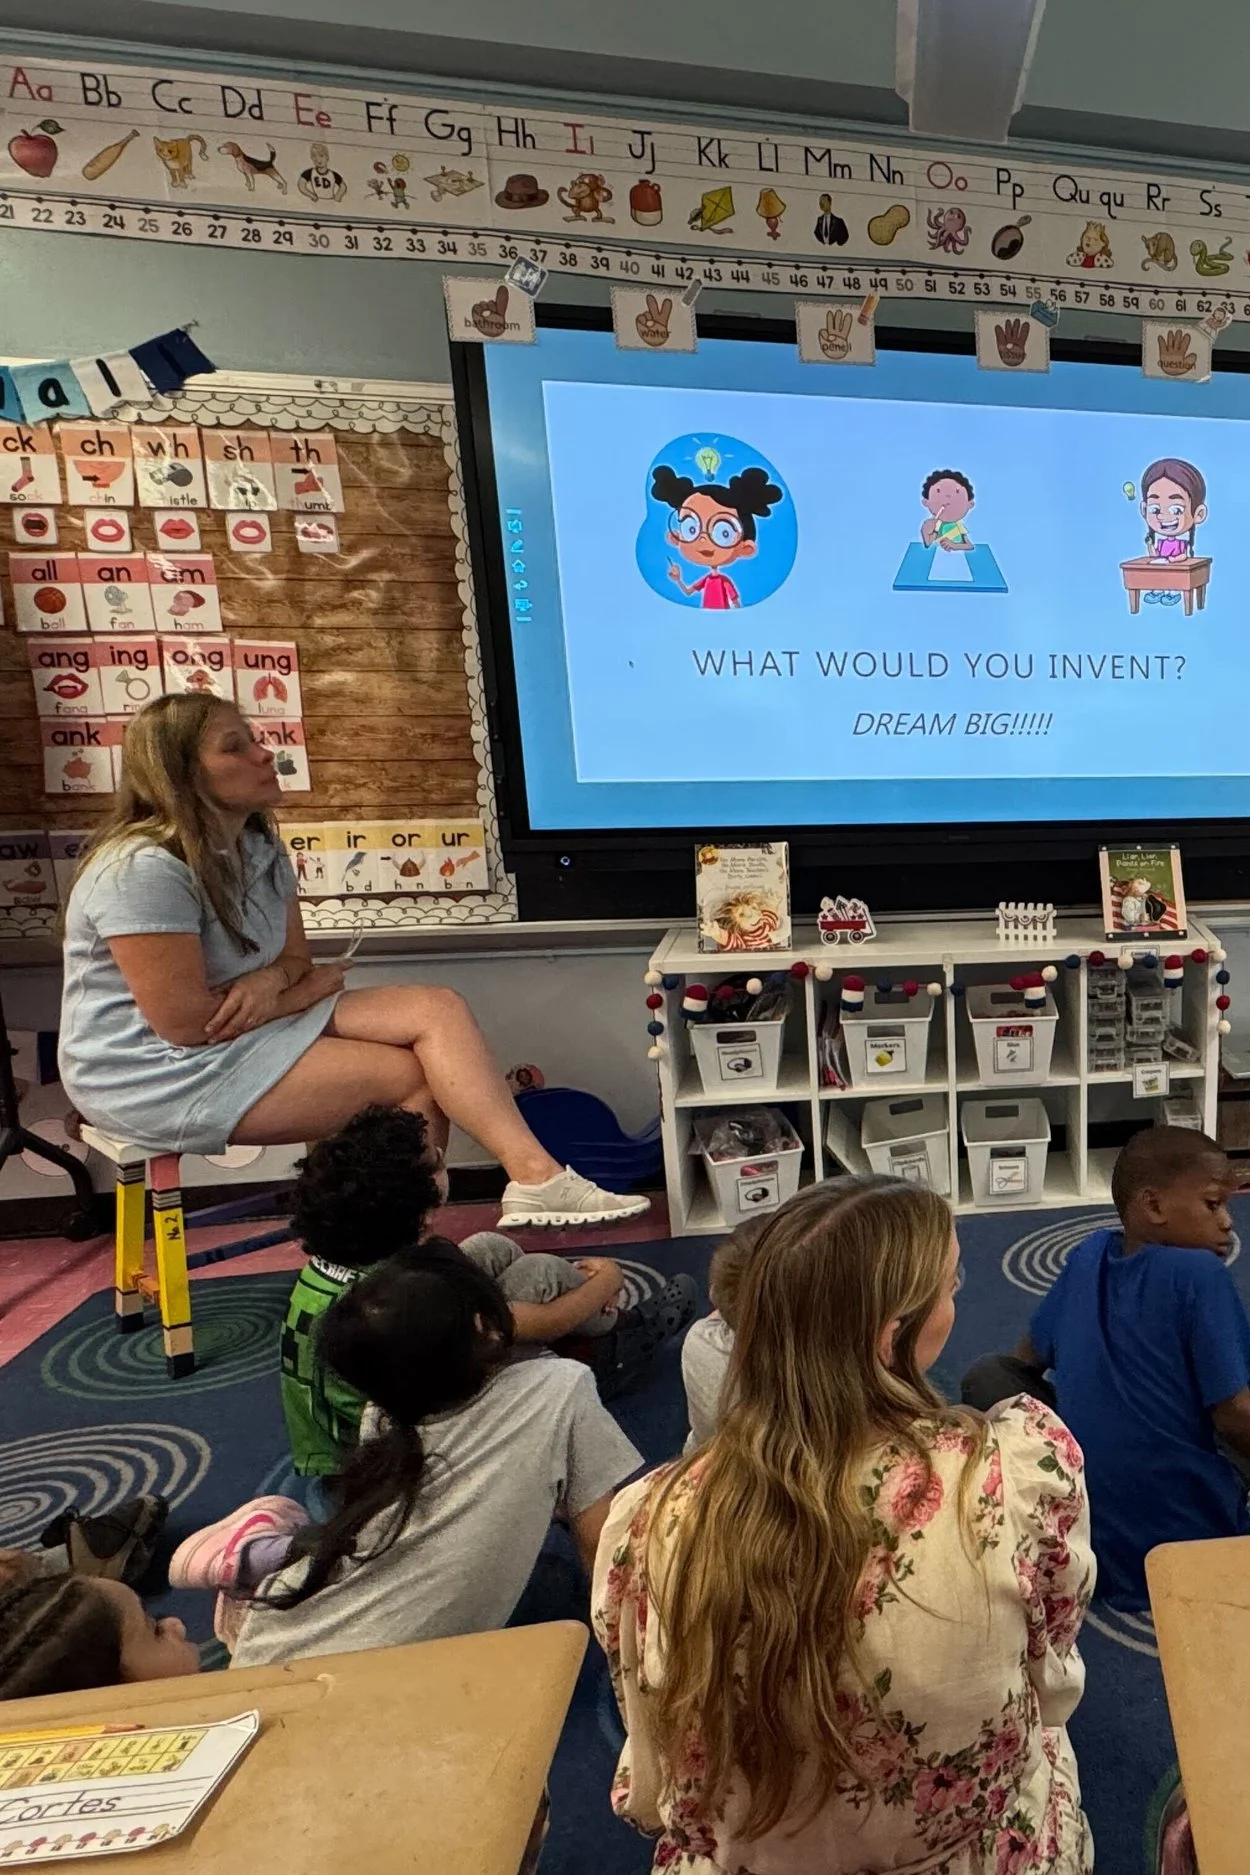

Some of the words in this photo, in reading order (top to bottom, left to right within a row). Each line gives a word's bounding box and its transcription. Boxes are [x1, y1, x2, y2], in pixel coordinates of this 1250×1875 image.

[9, 67, 52, 101] Aa
[80, 74, 122, 107] Bb
[152, 80, 193, 114] Cc
[221, 86, 263, 120] Dd
[294, 94, 331, 128] Ee
[366, 101, 398, 134] Ff
[425, 110, 472, 156] Gg
[497, 117, 536, 148] Hh
[565, 123, 594, 154] Ii
[629, 131, 655, 174] Jj
[698, 137, 729, 168] Kk
[758, 143, 778, 172] Ll
[805, 147, 851, 179] Mm
[870, 154, 903, 185] Nn
[927, 161, 968, 191] Oo
[997, 168, 1024, 209] Pp
[1053, 175, 1089, 204] Qu
[1100, 190, 1124, 218] qu
[1147, 183, 1170, 211] Rr
[1200, 191, 1222, 218] Ss
[315, 175, 331, 190] ED
[0, 205, 14, 219] 21
[65, 210, 86, 225] 23
[139, 218, 159, 233] 25
[208, 224, 227, 239] 27
[309, 234, 329, 249] 30
[373, 238, 392, 252] 32
[437, 240, 456, 255] 34
[499, 246, 518, 259] 36
[559, 252, 578, 266] 38
[620, 261, 640, 274] 40
[675, 267, 694, 280] 42
[762, 272, 780, 285] 45
[817, 276, 833, 288] 47
[870, 278, 888, 291] 49
[925, 280, 936, 292] 51
[974, 284, 990, 296] 53
[1026, 287, 1041, 299] 55
[1075, 291, 1089, 303] 57
[1150, 298, 1164, 311] 60
[1197, 300, 1212, 312] 62
[464, 318, 520, 331] bathroom
[641, 328, 672, 339] water
[1157, 359, 1196, 371] question
[3, 427, 36, 452] ck
[80, 430, 114, 456] ch
[148, 433, 188, 457] wh
[224, 437, 254, 461] sh
[290, 435, 321, 463] th
[32, 560, 58, 581] all
[98, 563, 131, 582] an
[41, 618, 65, 629] ball
[110, 619, 134, 629] fan
[174, 619, 204, 630] ham
[38, 648, 89, 673] ang
[110, 646, 148, 671] ing
[172, 648, 224, 671] ong
[244, 652, 291, 676] ung
[692, 650, 799, 677] WHAT
[816, 652, 949, 678] WOULD
[964, 654, 1033, 679] YOU
[1050, 654, 1187, 680] INVENT?
[56, 703, 88, 714] fang
[258, 704, 285, 714] lung
[51, 724, 100, 746] ank
[853, 713, 956, 736] DREAM
[964, 713, 1053, 736] BIG!!!!!
[62, 780, 96, 791] bank
[291, 835, 320, 850] er
[347, 832, 366, 848] ir
[392, 832, 421, 847] or
[442, 832, 469, 846] ur
[0, 1790, 122, 1824] Cortes
